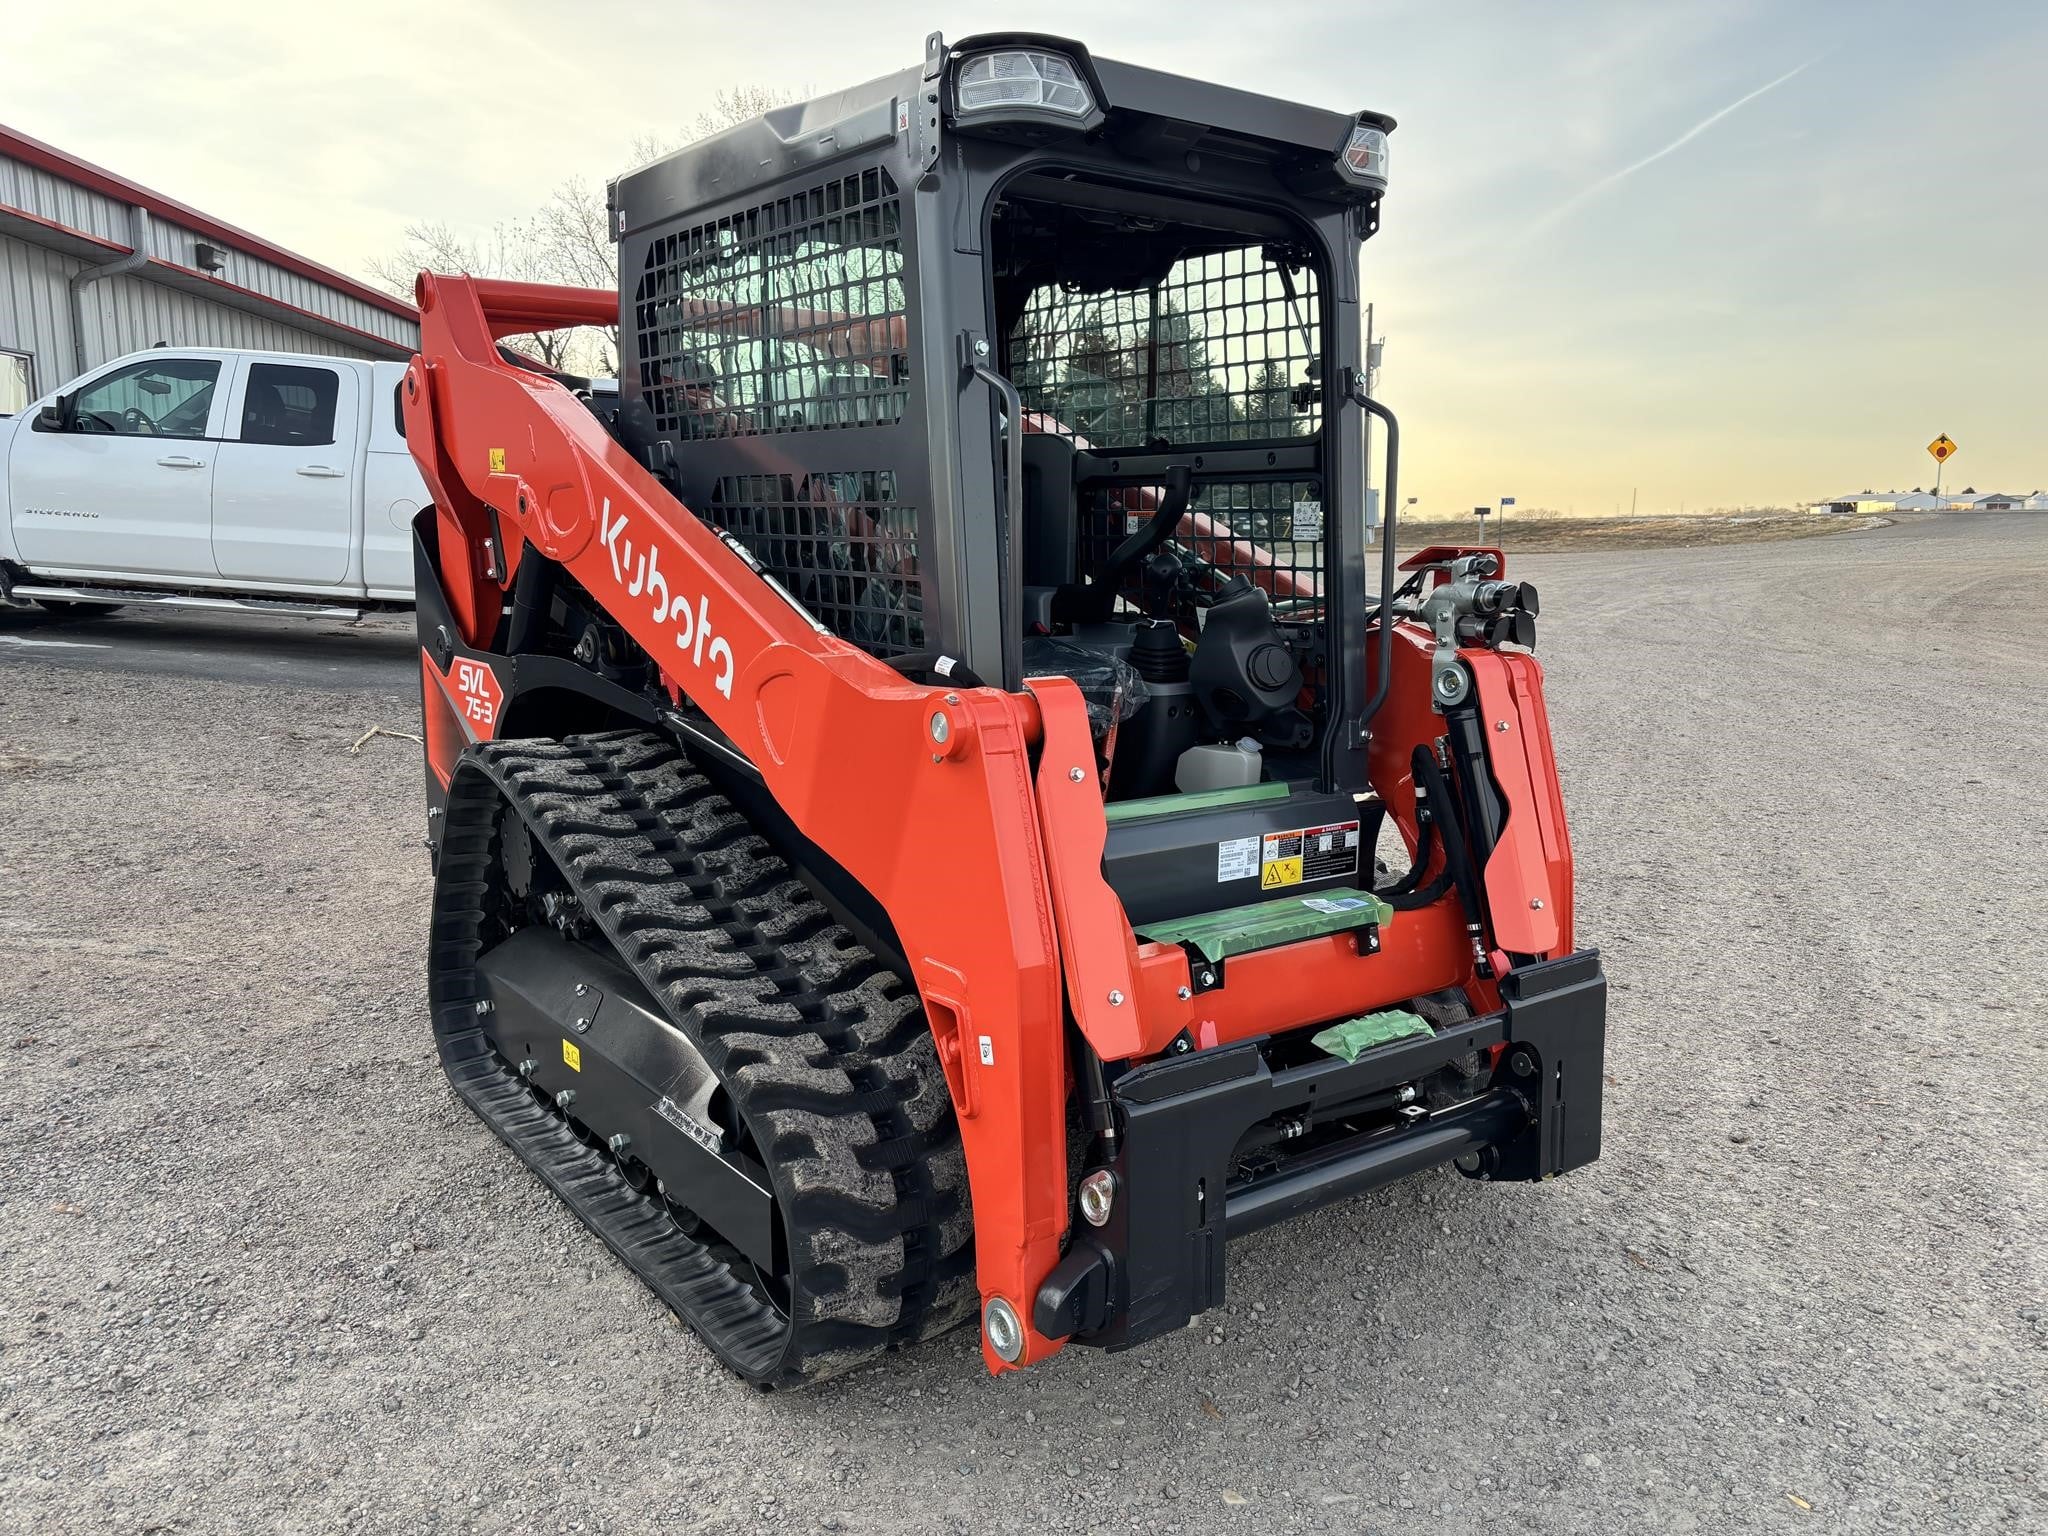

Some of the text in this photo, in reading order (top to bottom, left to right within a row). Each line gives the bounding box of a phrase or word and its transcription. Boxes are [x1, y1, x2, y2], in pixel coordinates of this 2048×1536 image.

[25, 507, 99, 518] SILVERADO
[600, 497, 734, 700] Kubota
[458, 664, 490, 698] SVL
[465, 695, 493, 724] 75-3
